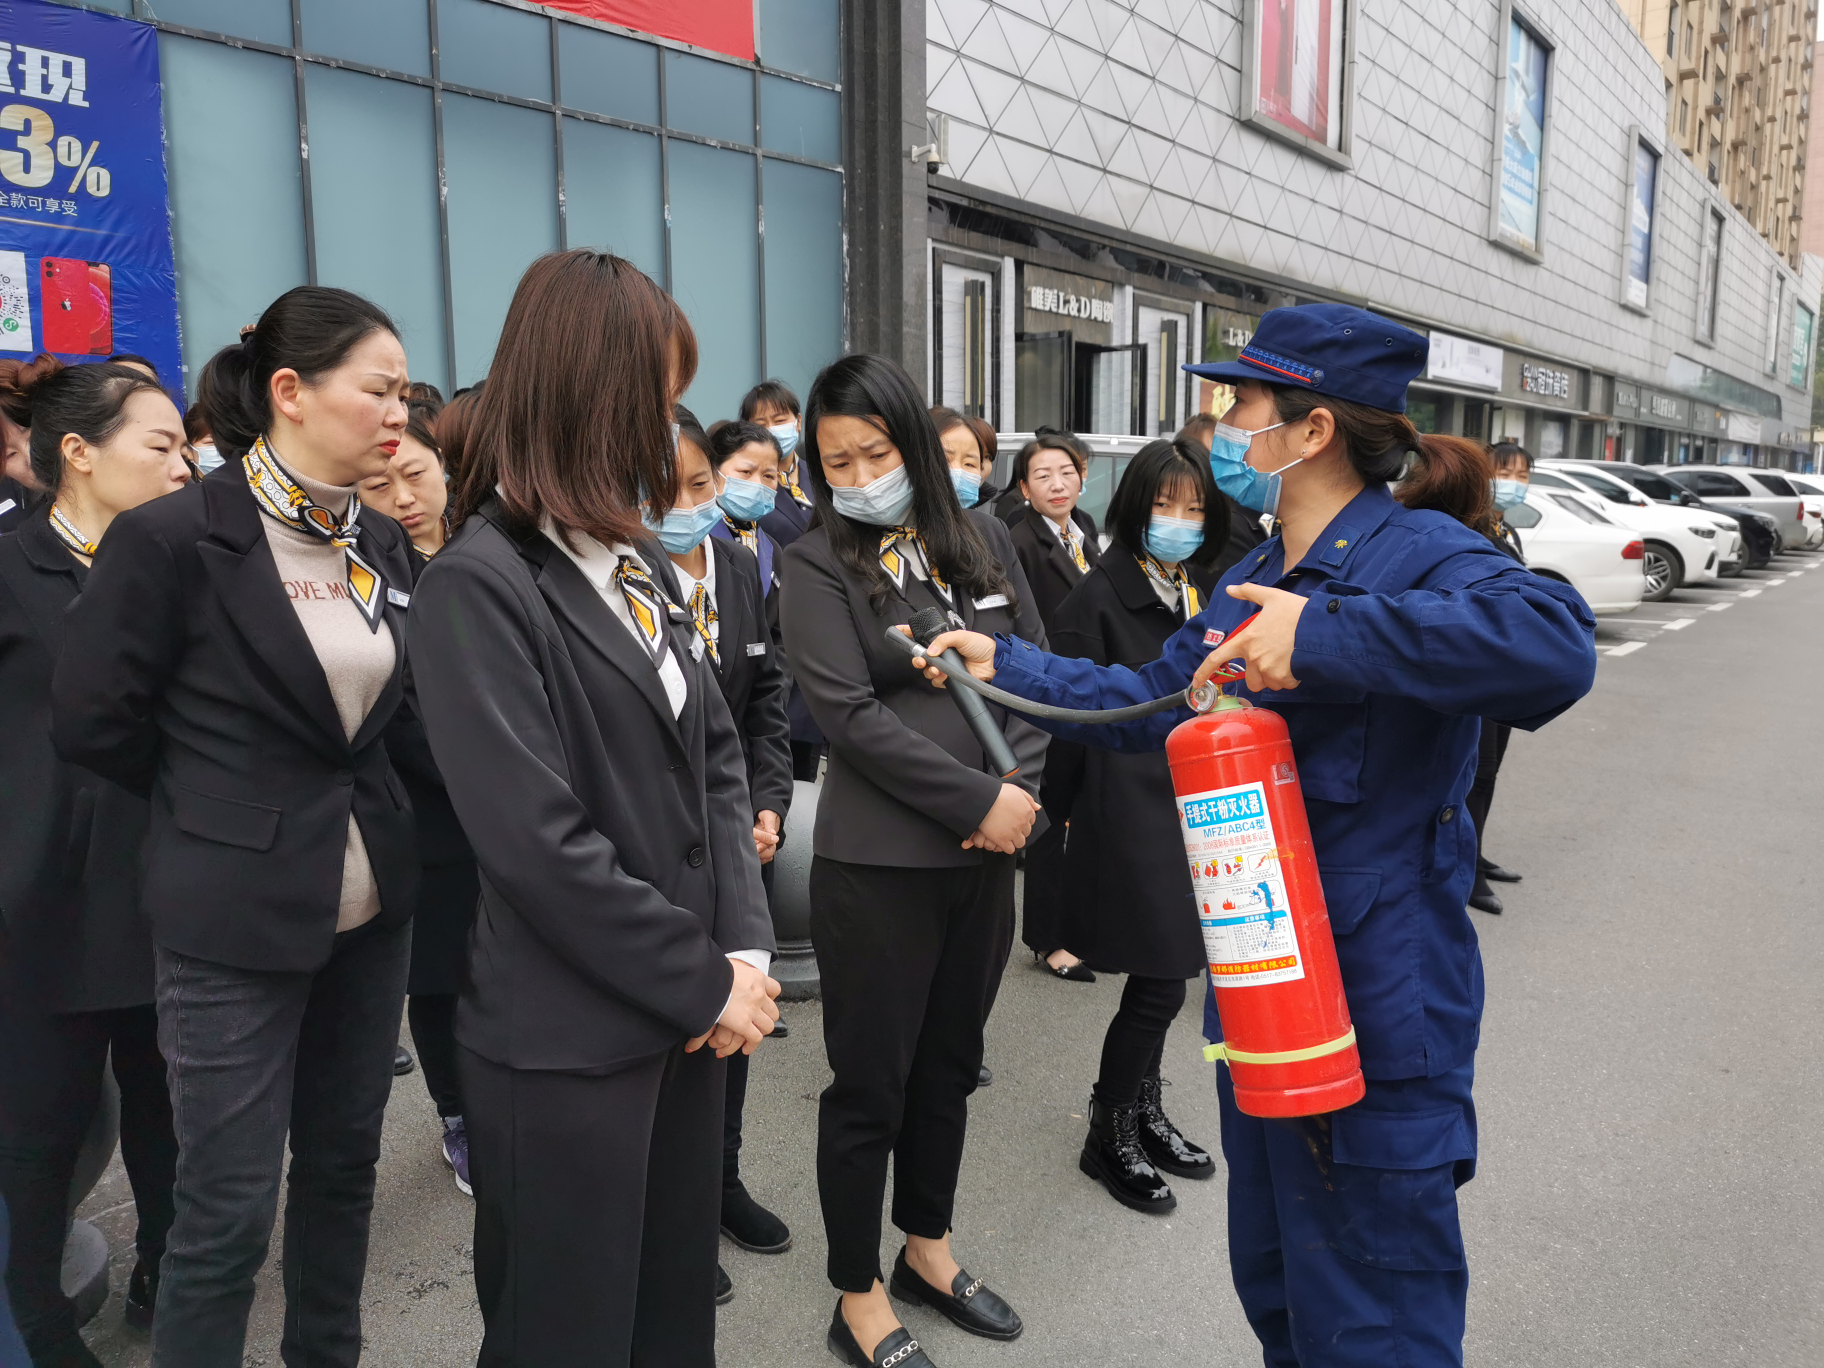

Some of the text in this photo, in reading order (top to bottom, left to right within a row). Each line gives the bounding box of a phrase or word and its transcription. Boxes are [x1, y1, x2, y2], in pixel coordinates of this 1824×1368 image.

[0, 104, 111, 197] 3%
[1186, 793, 1261, 825] 手提式干粉灭火器
[1203, 818, 1266, 838] MFZ/ABC4型
